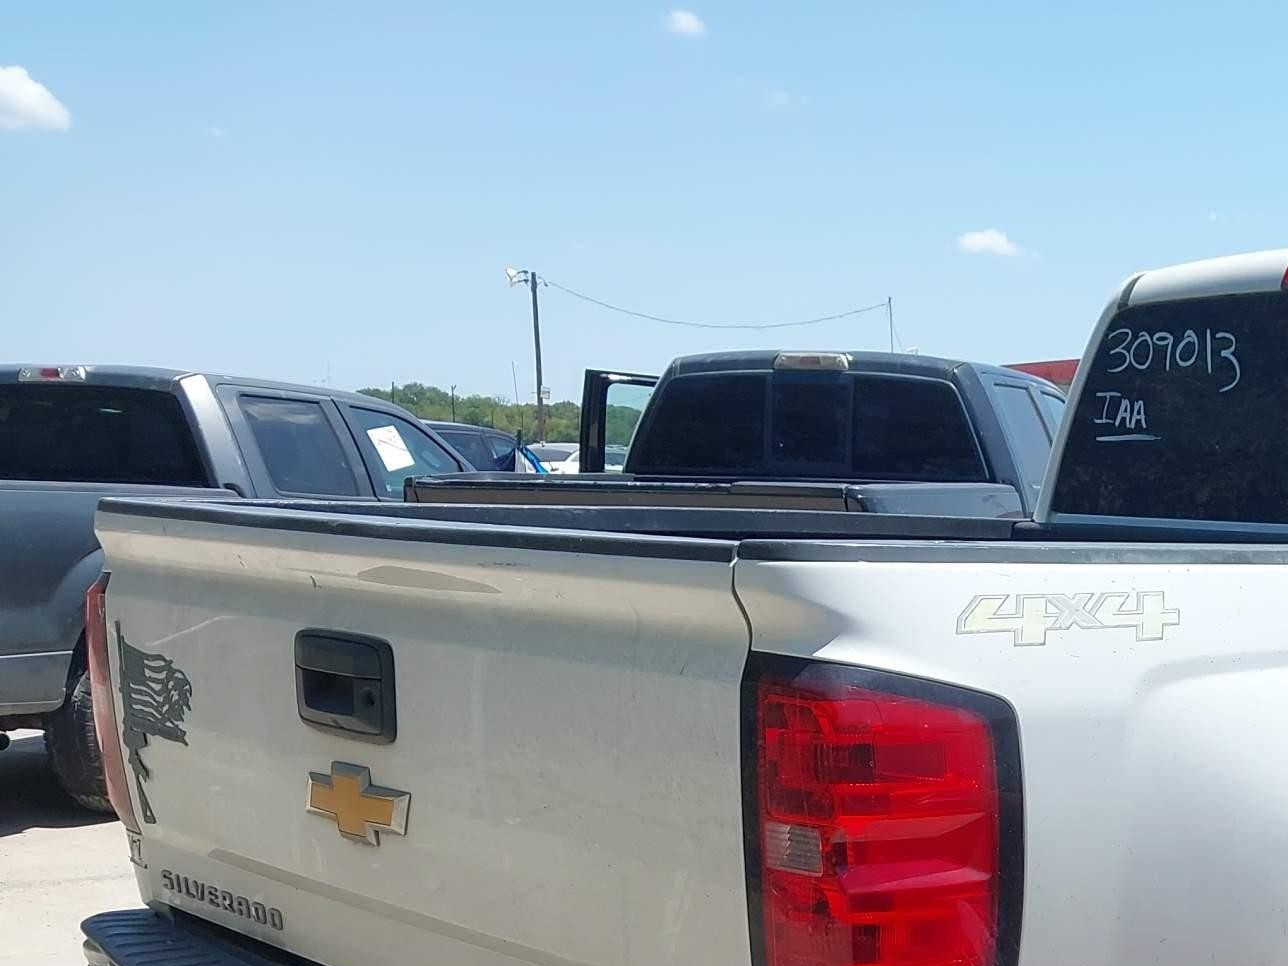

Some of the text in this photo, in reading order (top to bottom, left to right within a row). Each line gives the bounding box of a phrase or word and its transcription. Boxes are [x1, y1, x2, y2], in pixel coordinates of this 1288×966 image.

[1106, 327, 1241, 393] 309013
[1093, 391, 1147, 429] IAA
[160, 869, 284, 931] SILVERADO
